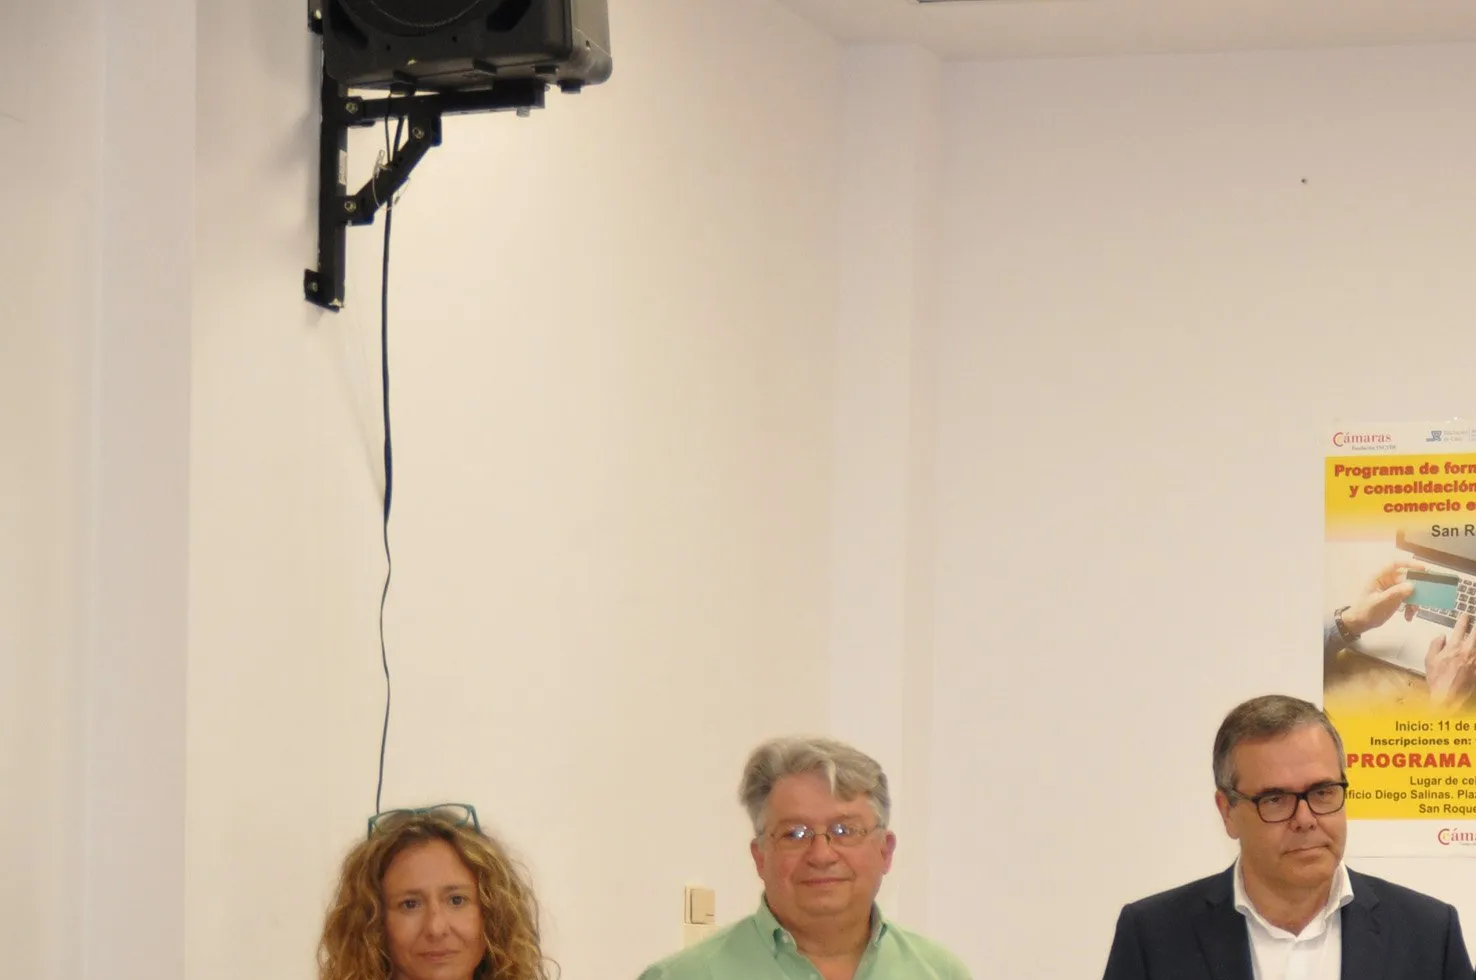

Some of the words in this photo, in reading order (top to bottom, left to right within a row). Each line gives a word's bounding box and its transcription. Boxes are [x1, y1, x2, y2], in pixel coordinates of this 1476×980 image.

[1333, 432, 1392, 446] Cámaras
[1334, 463, 1414, 478] Programa
[1419, 462, 1439, 475] de
[1349, 485, 1359, 497] y
[1384, 500, 1460, 513] comercio
[1431, 525, 1459, 537] San
[1395, 721, 1433, 731] Inicio:
[1438, 721, 1450, 731] 11
[1455, 721, 1470, 731] de
[1370, 737, 1450, 747] Inscripciones
[1454, 737, 1471, 746] en:
[1347, 753, 1472, 768] PROGRAMA
[1410, 776, 1441, 787] Lugar
[1445, 776, 1459, 785] de
[1376, 790, 1406, 801] Diego
[1410, 790, 1453, 799] Salinas.
[1419, 804, 1441, 813] San
